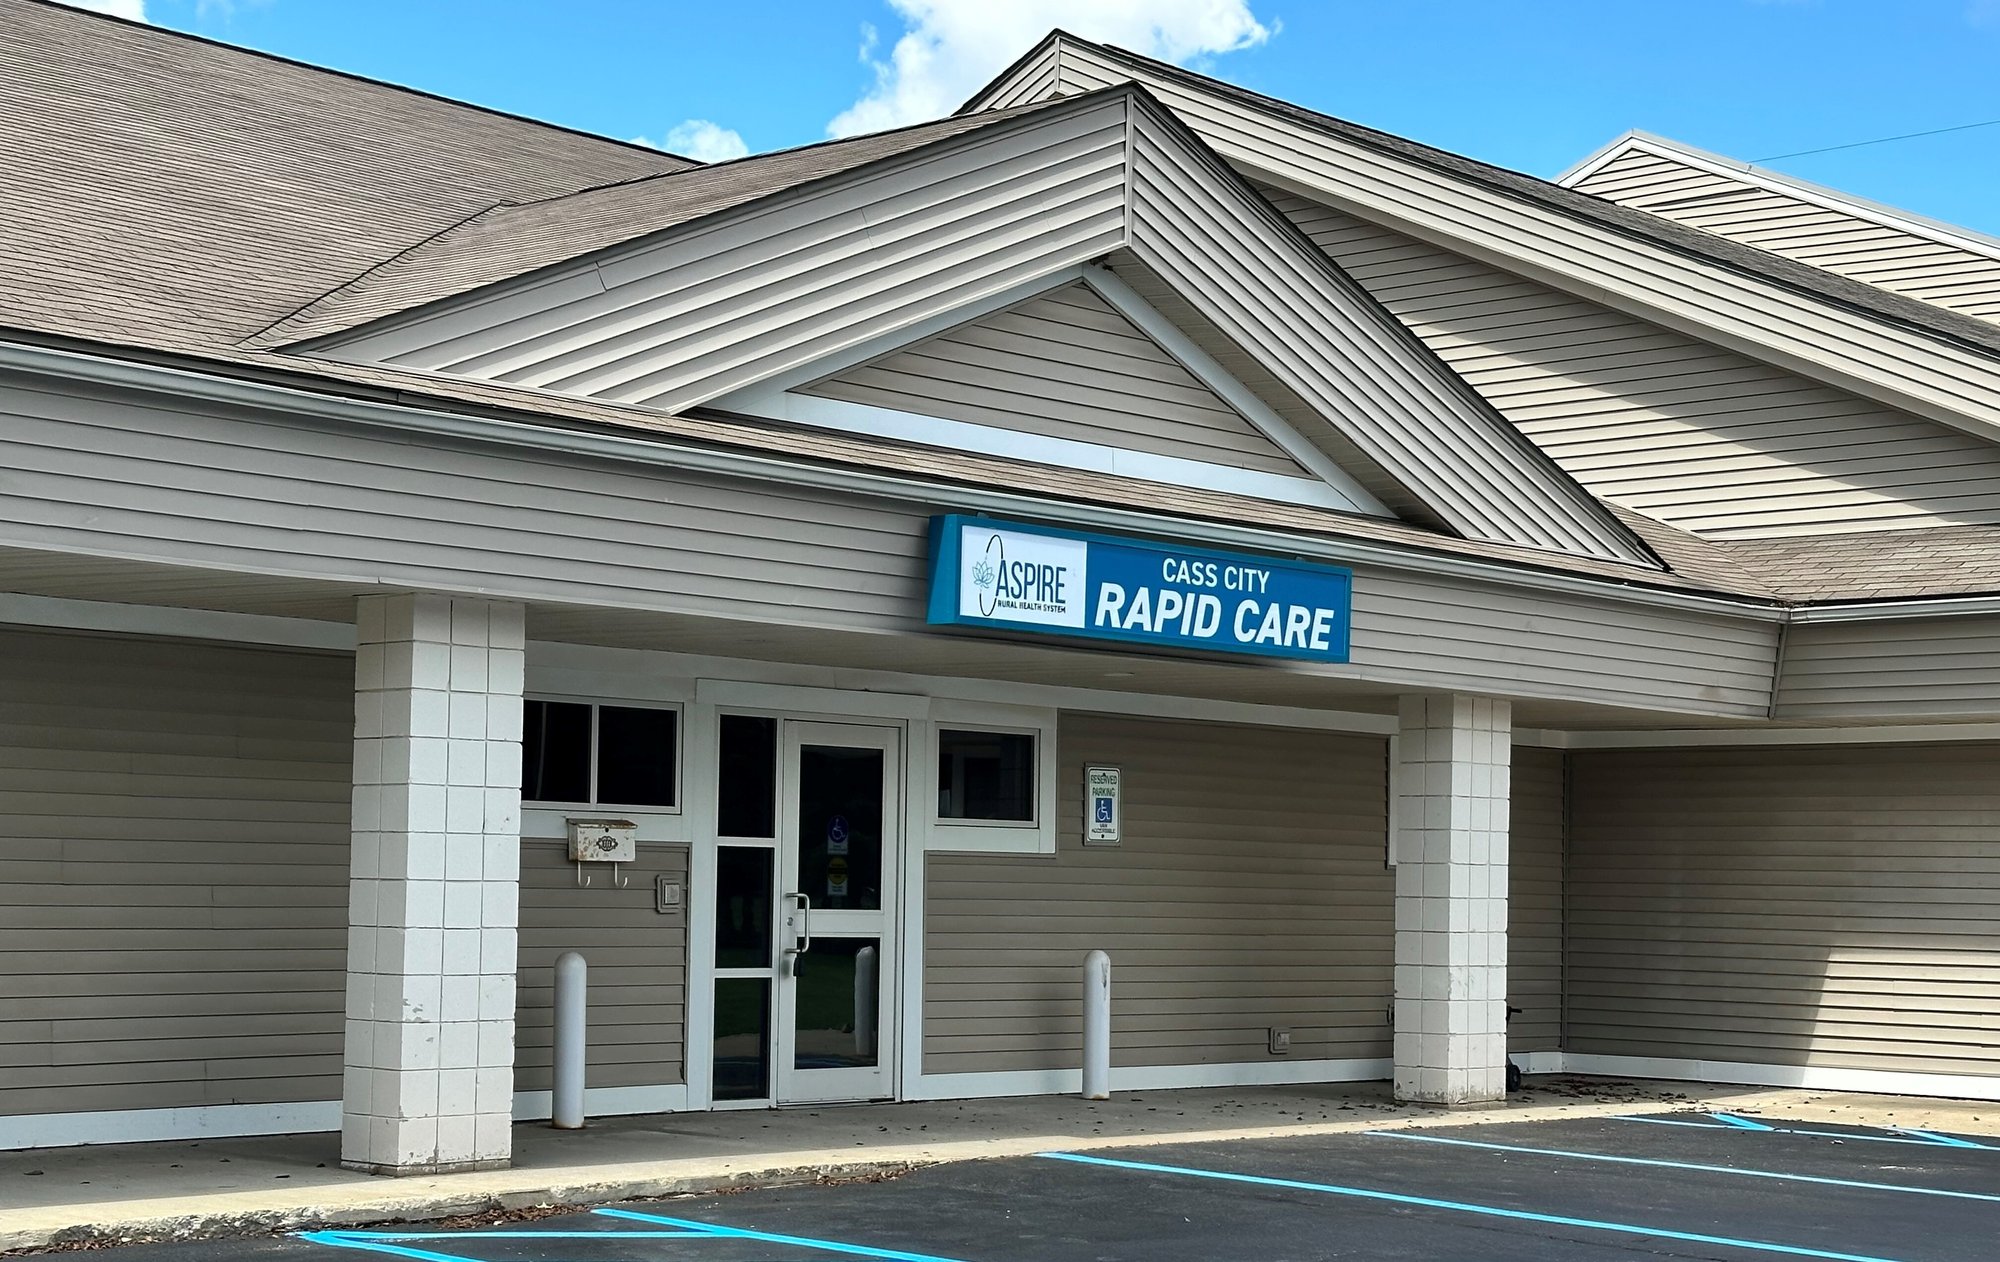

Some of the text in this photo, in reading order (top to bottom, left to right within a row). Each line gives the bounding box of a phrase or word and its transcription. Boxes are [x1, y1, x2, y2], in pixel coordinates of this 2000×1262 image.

[995, 560, 1067, 604] ASPIRE
[1163, 558, 1270, 594] CASS CITY
[997, 599, 1066, 614] RURAL HEALTH SYSTEM
[1094, 582, 1335, 650] RAPID CARE
[1091, 775, 1117, 785] RESERVED
[1092, 787, 1115, 797] PARKING
